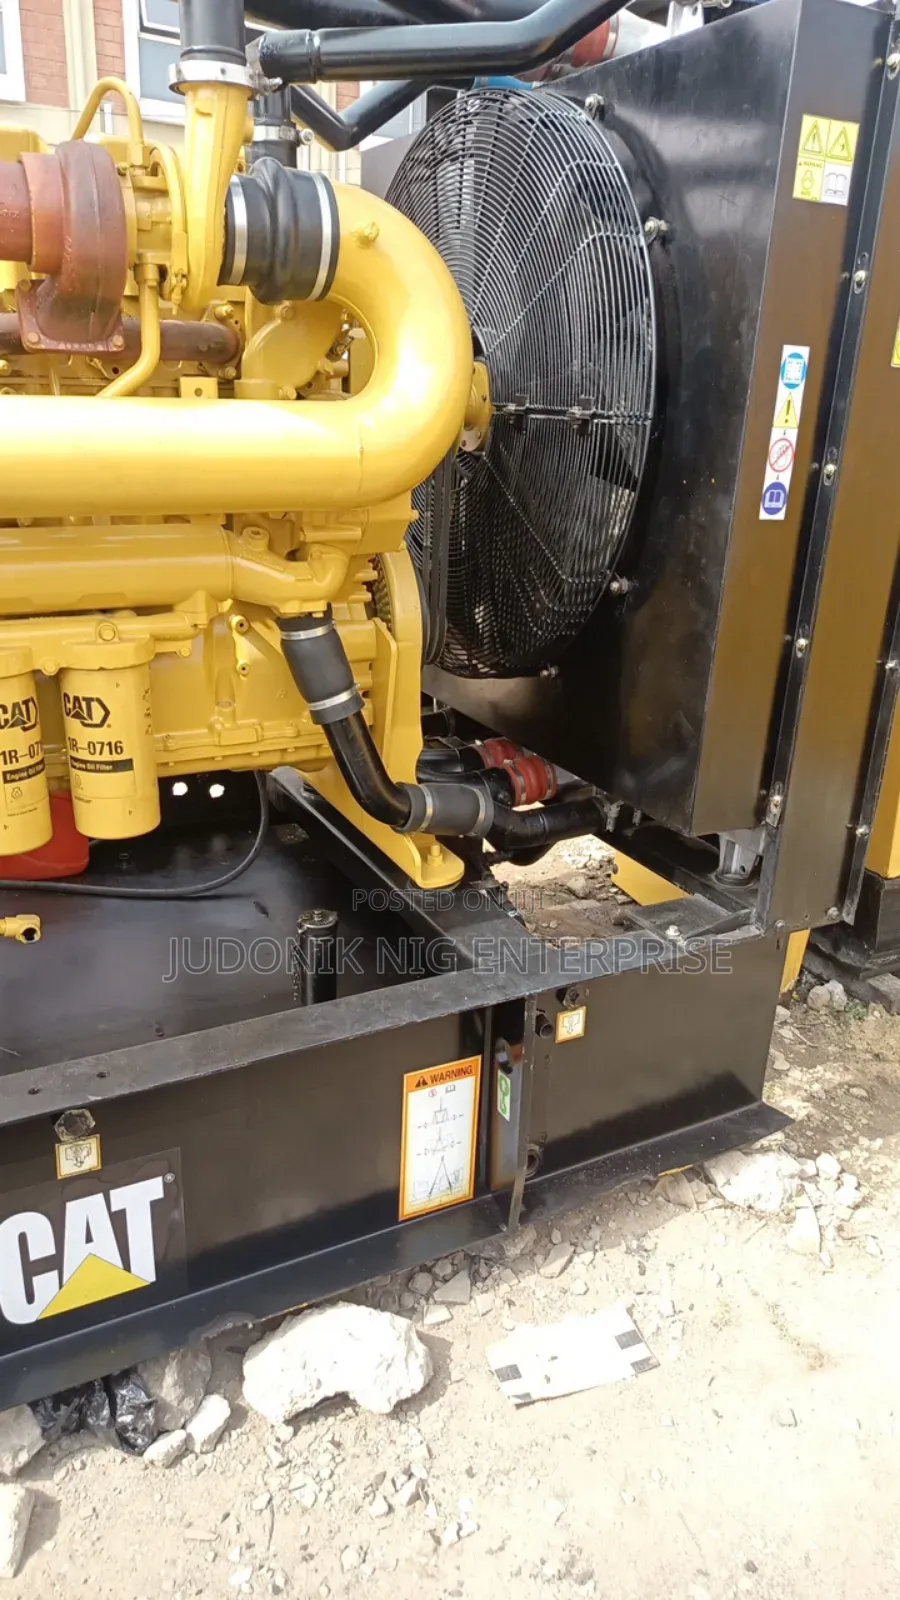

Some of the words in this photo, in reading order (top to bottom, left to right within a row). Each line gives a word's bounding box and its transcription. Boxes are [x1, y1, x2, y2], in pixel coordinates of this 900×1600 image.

[0, 698, 33, 729] CAT
[63, 692, 93, 721] CAT
[68, 736, 124, 756] 1R-0716
[6, 770, 28, 781] Engine
[430, 1065, 472, 1084] WARNING
[0, 1176, 164, 1324] CAT
